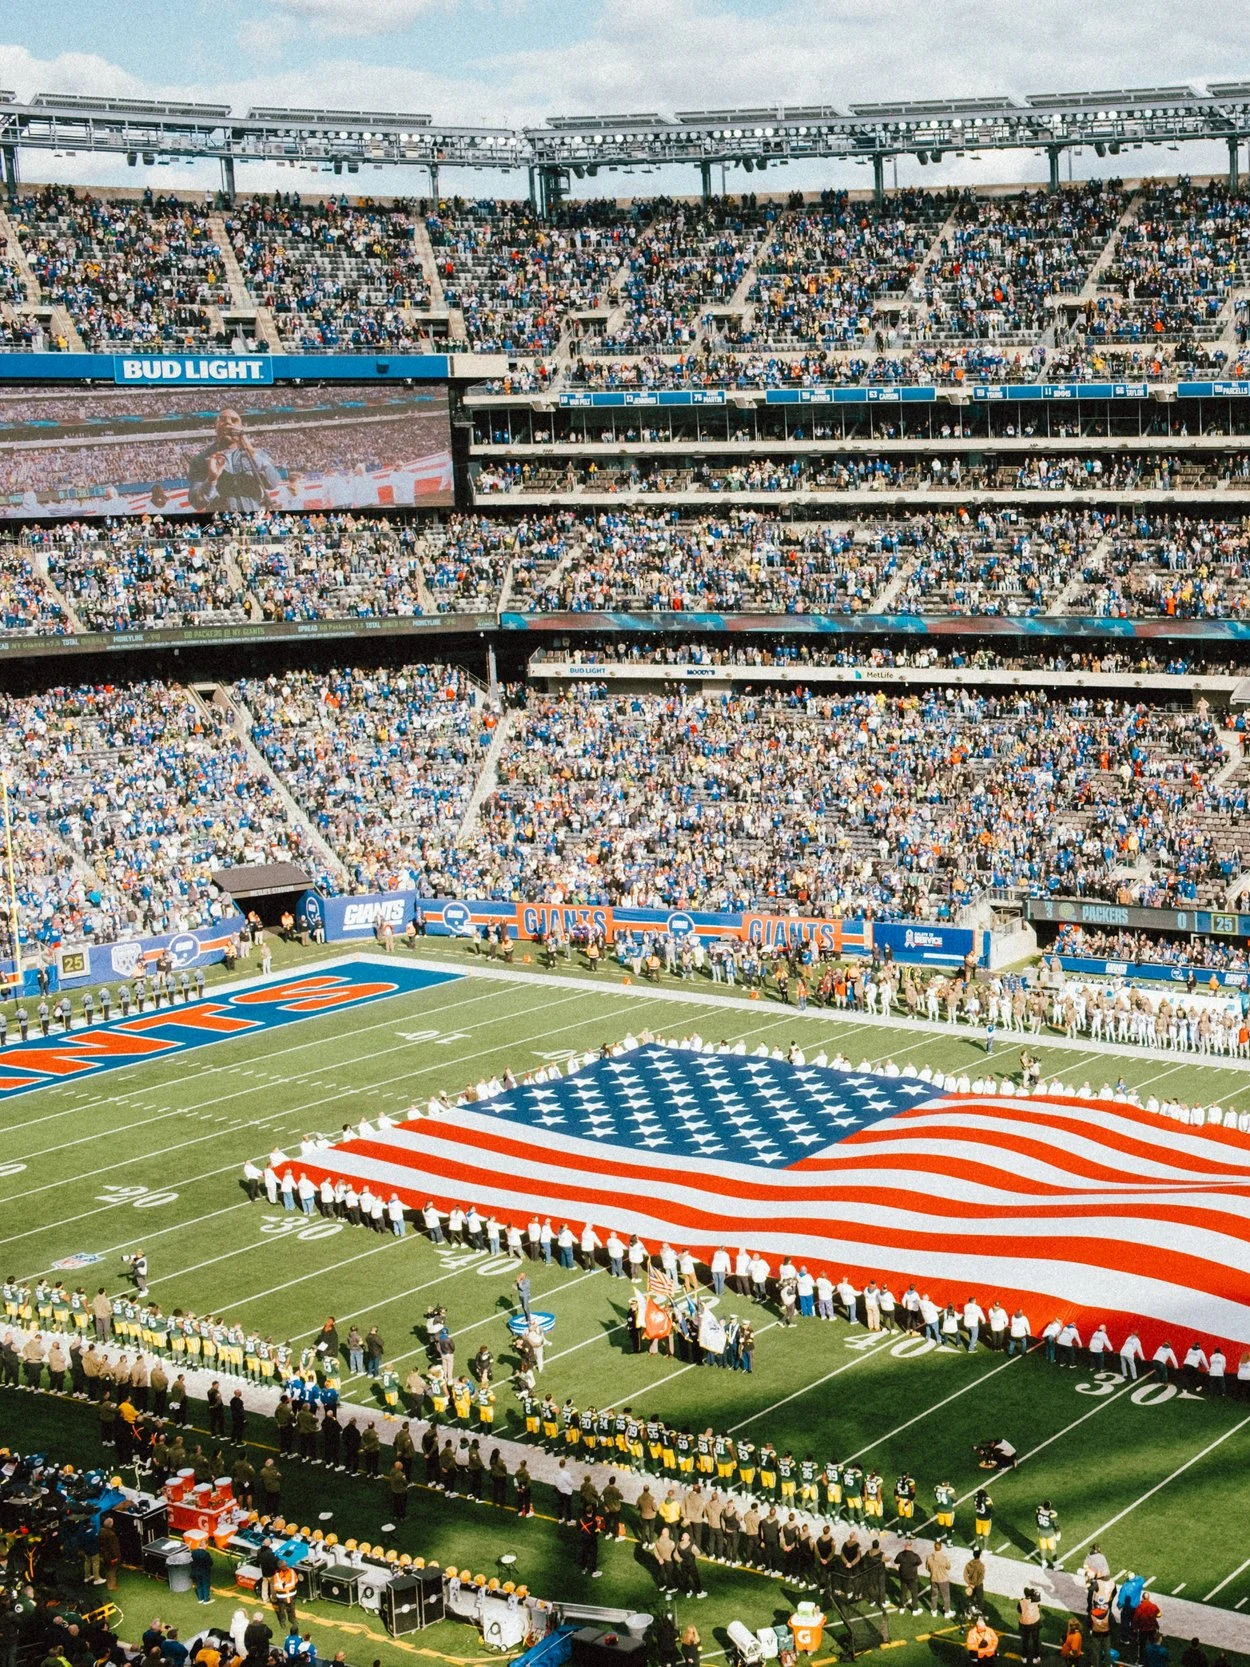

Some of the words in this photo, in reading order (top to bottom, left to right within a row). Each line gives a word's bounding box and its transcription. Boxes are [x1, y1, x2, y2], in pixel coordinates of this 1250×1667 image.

[123, 360, 182, 379] BUD
[194, 630, 222, 638] PACKERS
[585, 667, 605, 675] LIGHT
[866, 671, 893, 679] MetLife
[344, 899, 405, 925] GIANTS
[1082, 906, 1129, 924] PACKERS
[1177, 912, 1187, 930] 0
[1216, 917, 1233, 932] 25
[64, 956, 83, 971] 25
[94, 1185, 180, 1206] 20
[258, 1216, 343, 1240] 30
[437, 1250, 521, 1276] 40
[842, 1331, 936, 1357] 40
[1074, 1373, 1177, 1406] 30
[761, 1455, 767, 1466] 7
[797, 1629, 811, 1644] G
